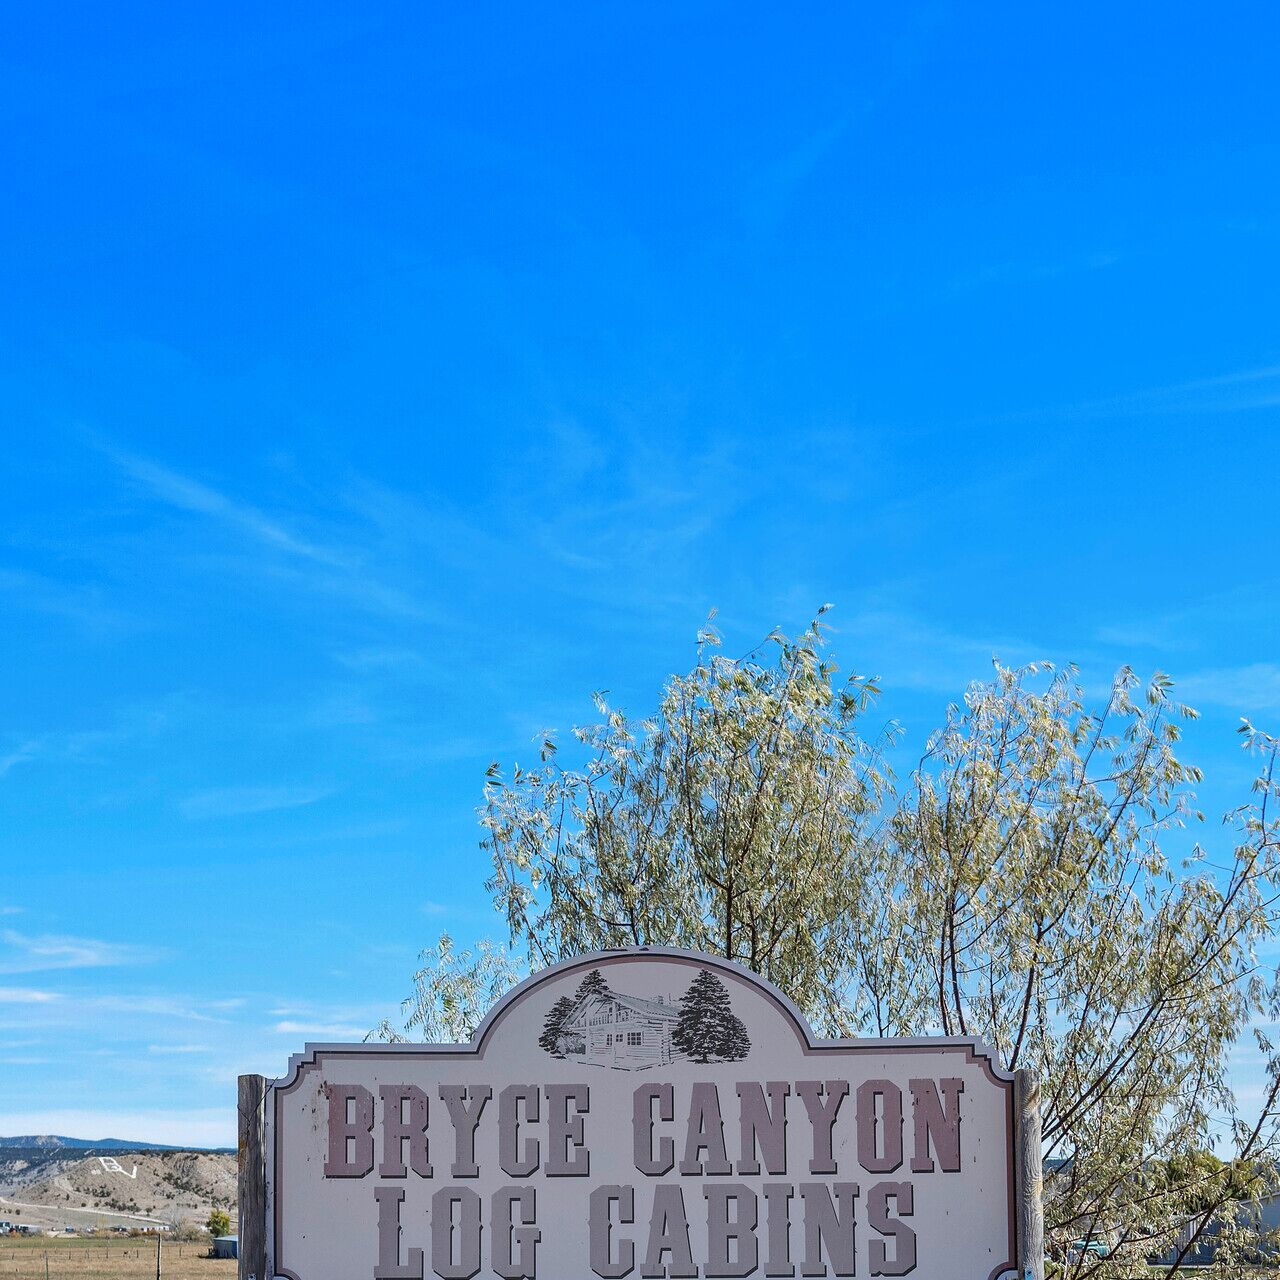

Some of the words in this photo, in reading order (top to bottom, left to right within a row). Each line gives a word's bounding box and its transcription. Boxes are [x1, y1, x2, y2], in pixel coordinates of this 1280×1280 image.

[324, 1084, 590, 1179] BRYCE
[632, 1078, 964, 1176] CANYON
[374, 1186, 542, 1280] LOG
[587, 1181, 918, 1279] CABINS
